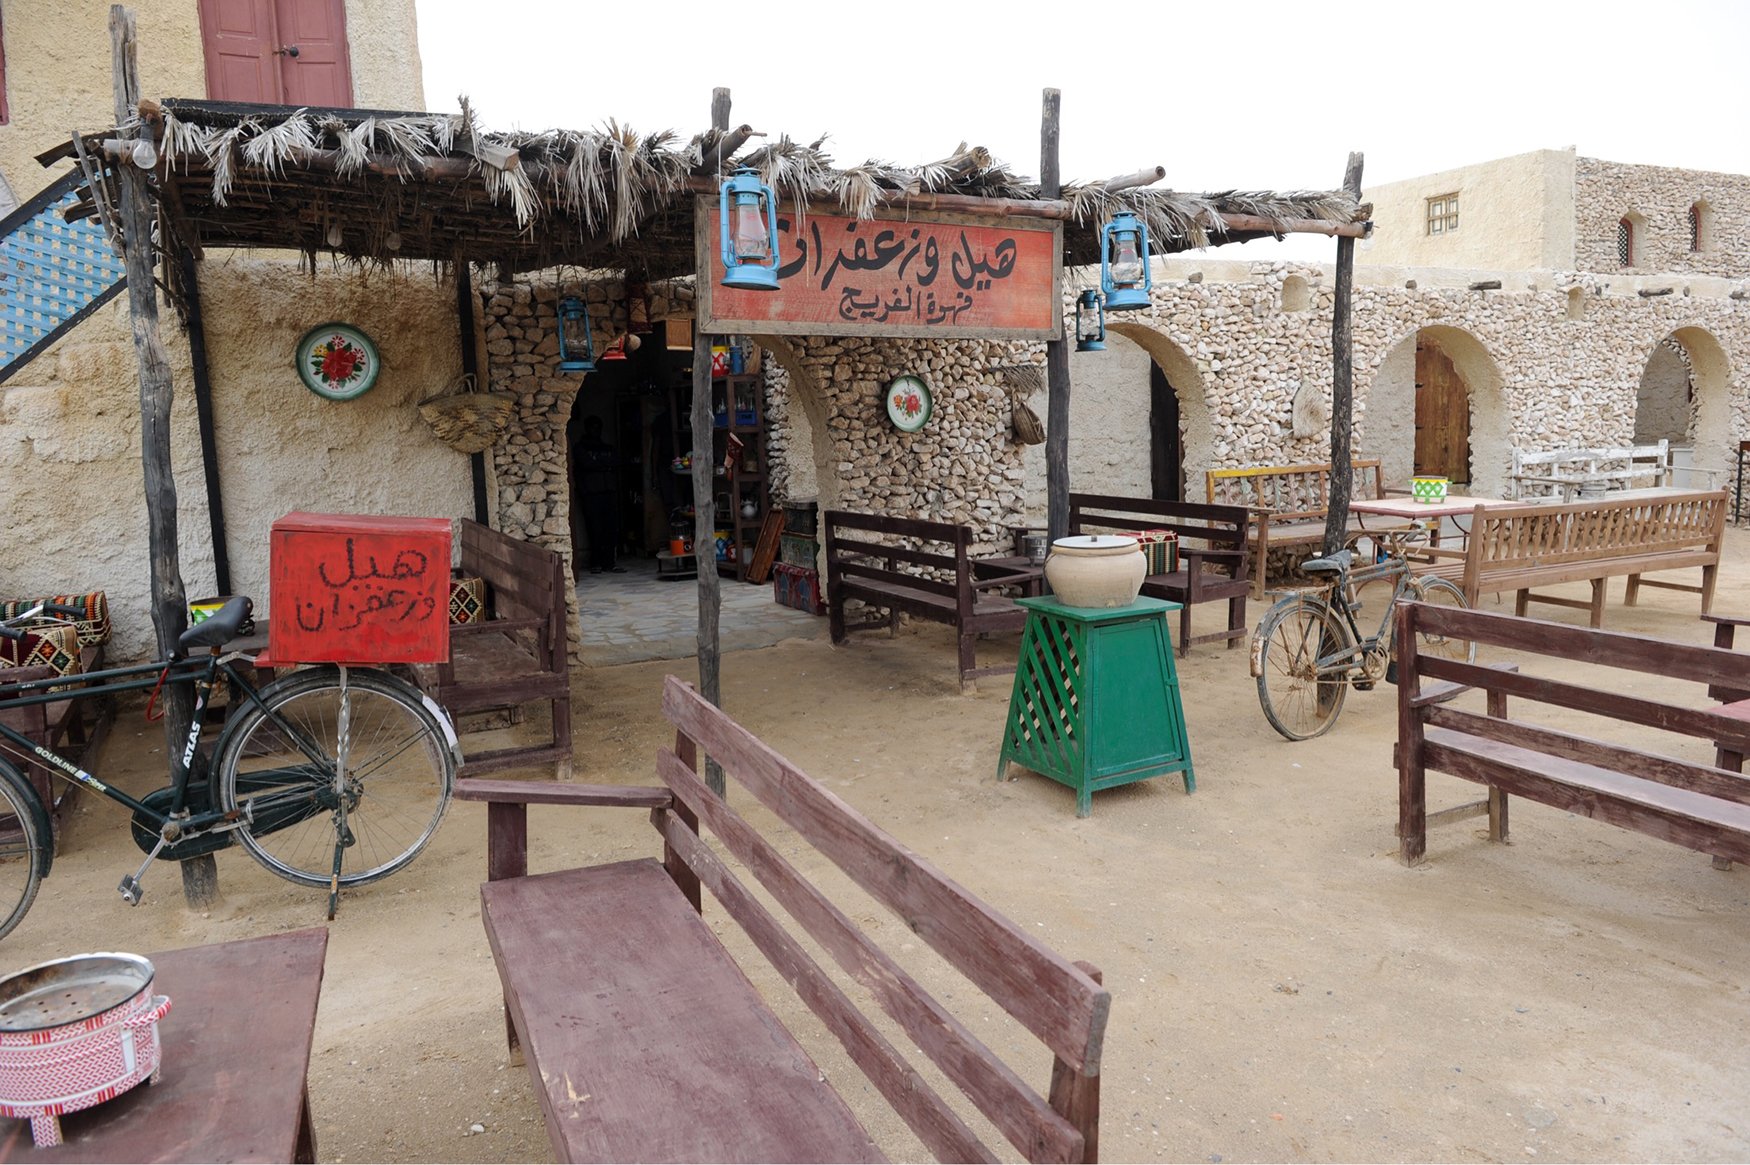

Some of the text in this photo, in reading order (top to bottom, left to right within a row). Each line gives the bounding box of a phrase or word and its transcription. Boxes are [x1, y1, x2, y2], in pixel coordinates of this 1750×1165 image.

[952, 230, 1017, 291] هيل
[839, 284, 973, 325] قهوة الفريج
[319, 537, 427, 591] هيل
[35, 746, 78, 775] GOLDLINE
[182, 721, 201, 769] ATLAS
